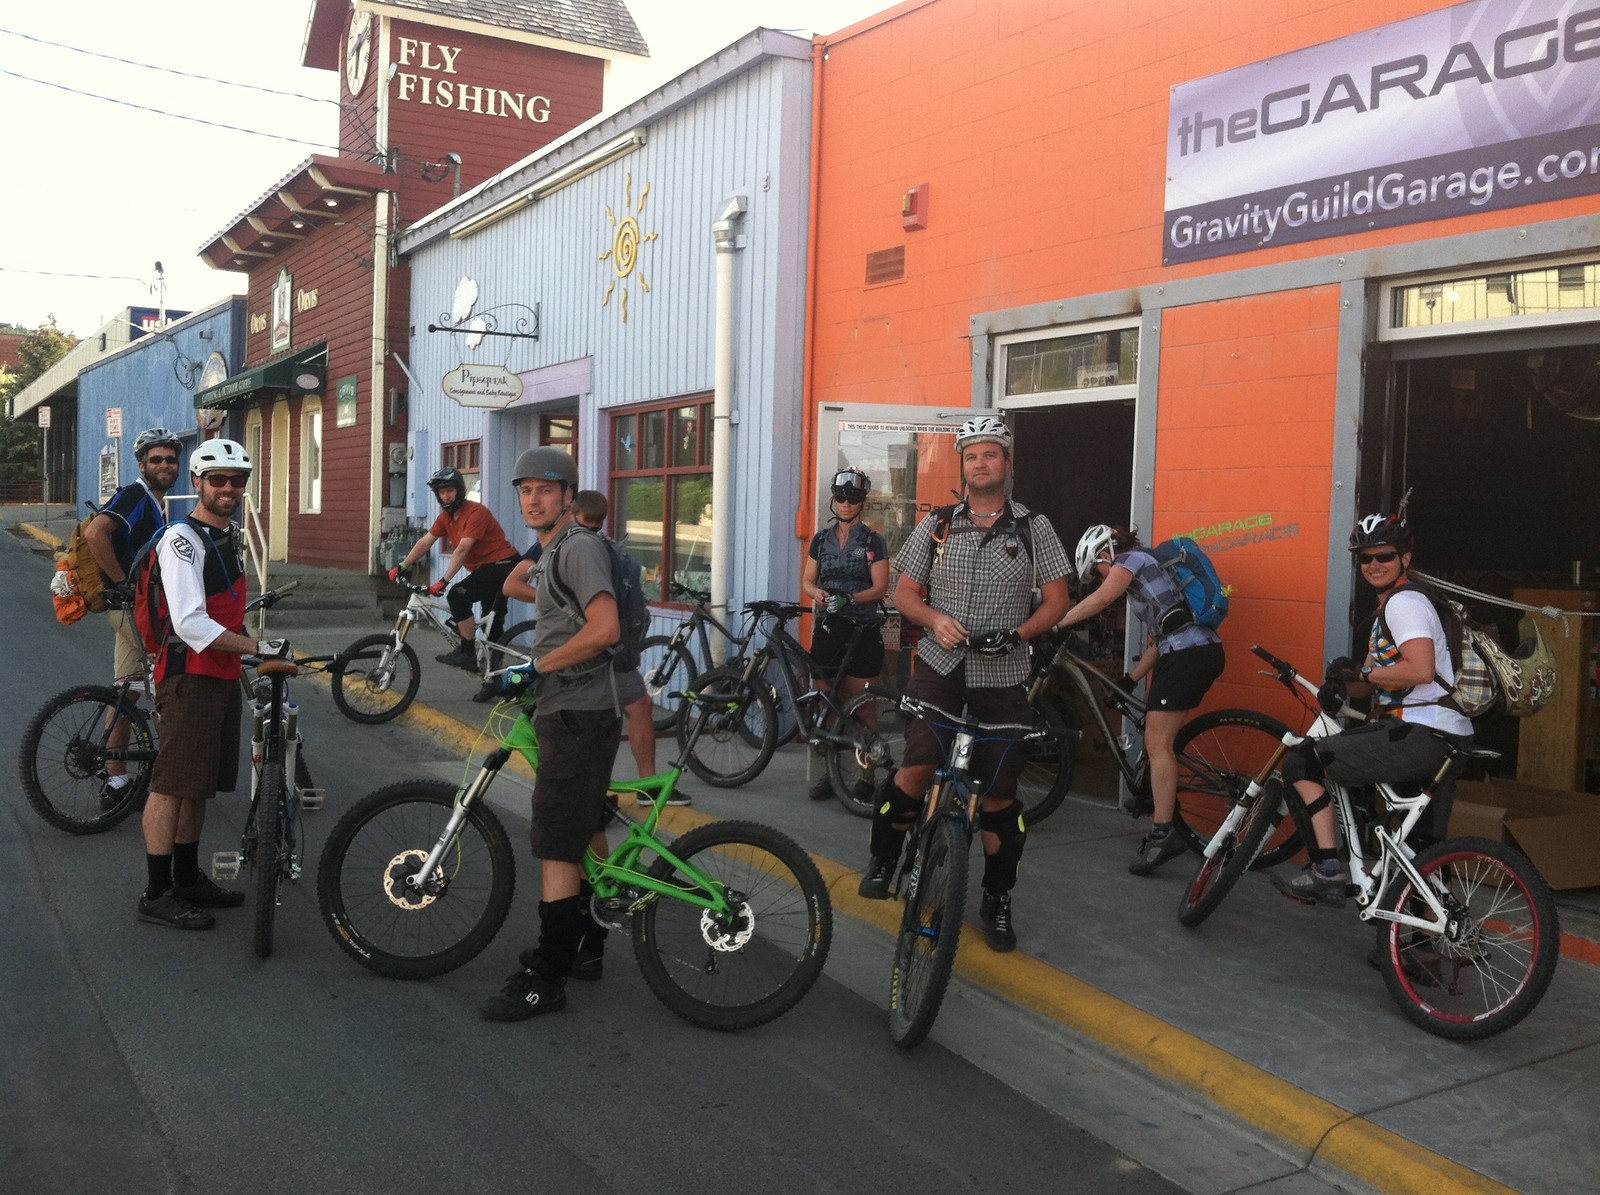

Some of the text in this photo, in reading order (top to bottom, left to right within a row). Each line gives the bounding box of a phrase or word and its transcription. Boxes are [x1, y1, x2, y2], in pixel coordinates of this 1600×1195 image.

[398, 37, 462, 74] FLY
[397, 72, 551, 123] FISHING
[1082, 375, 1115, 387] OPEN
